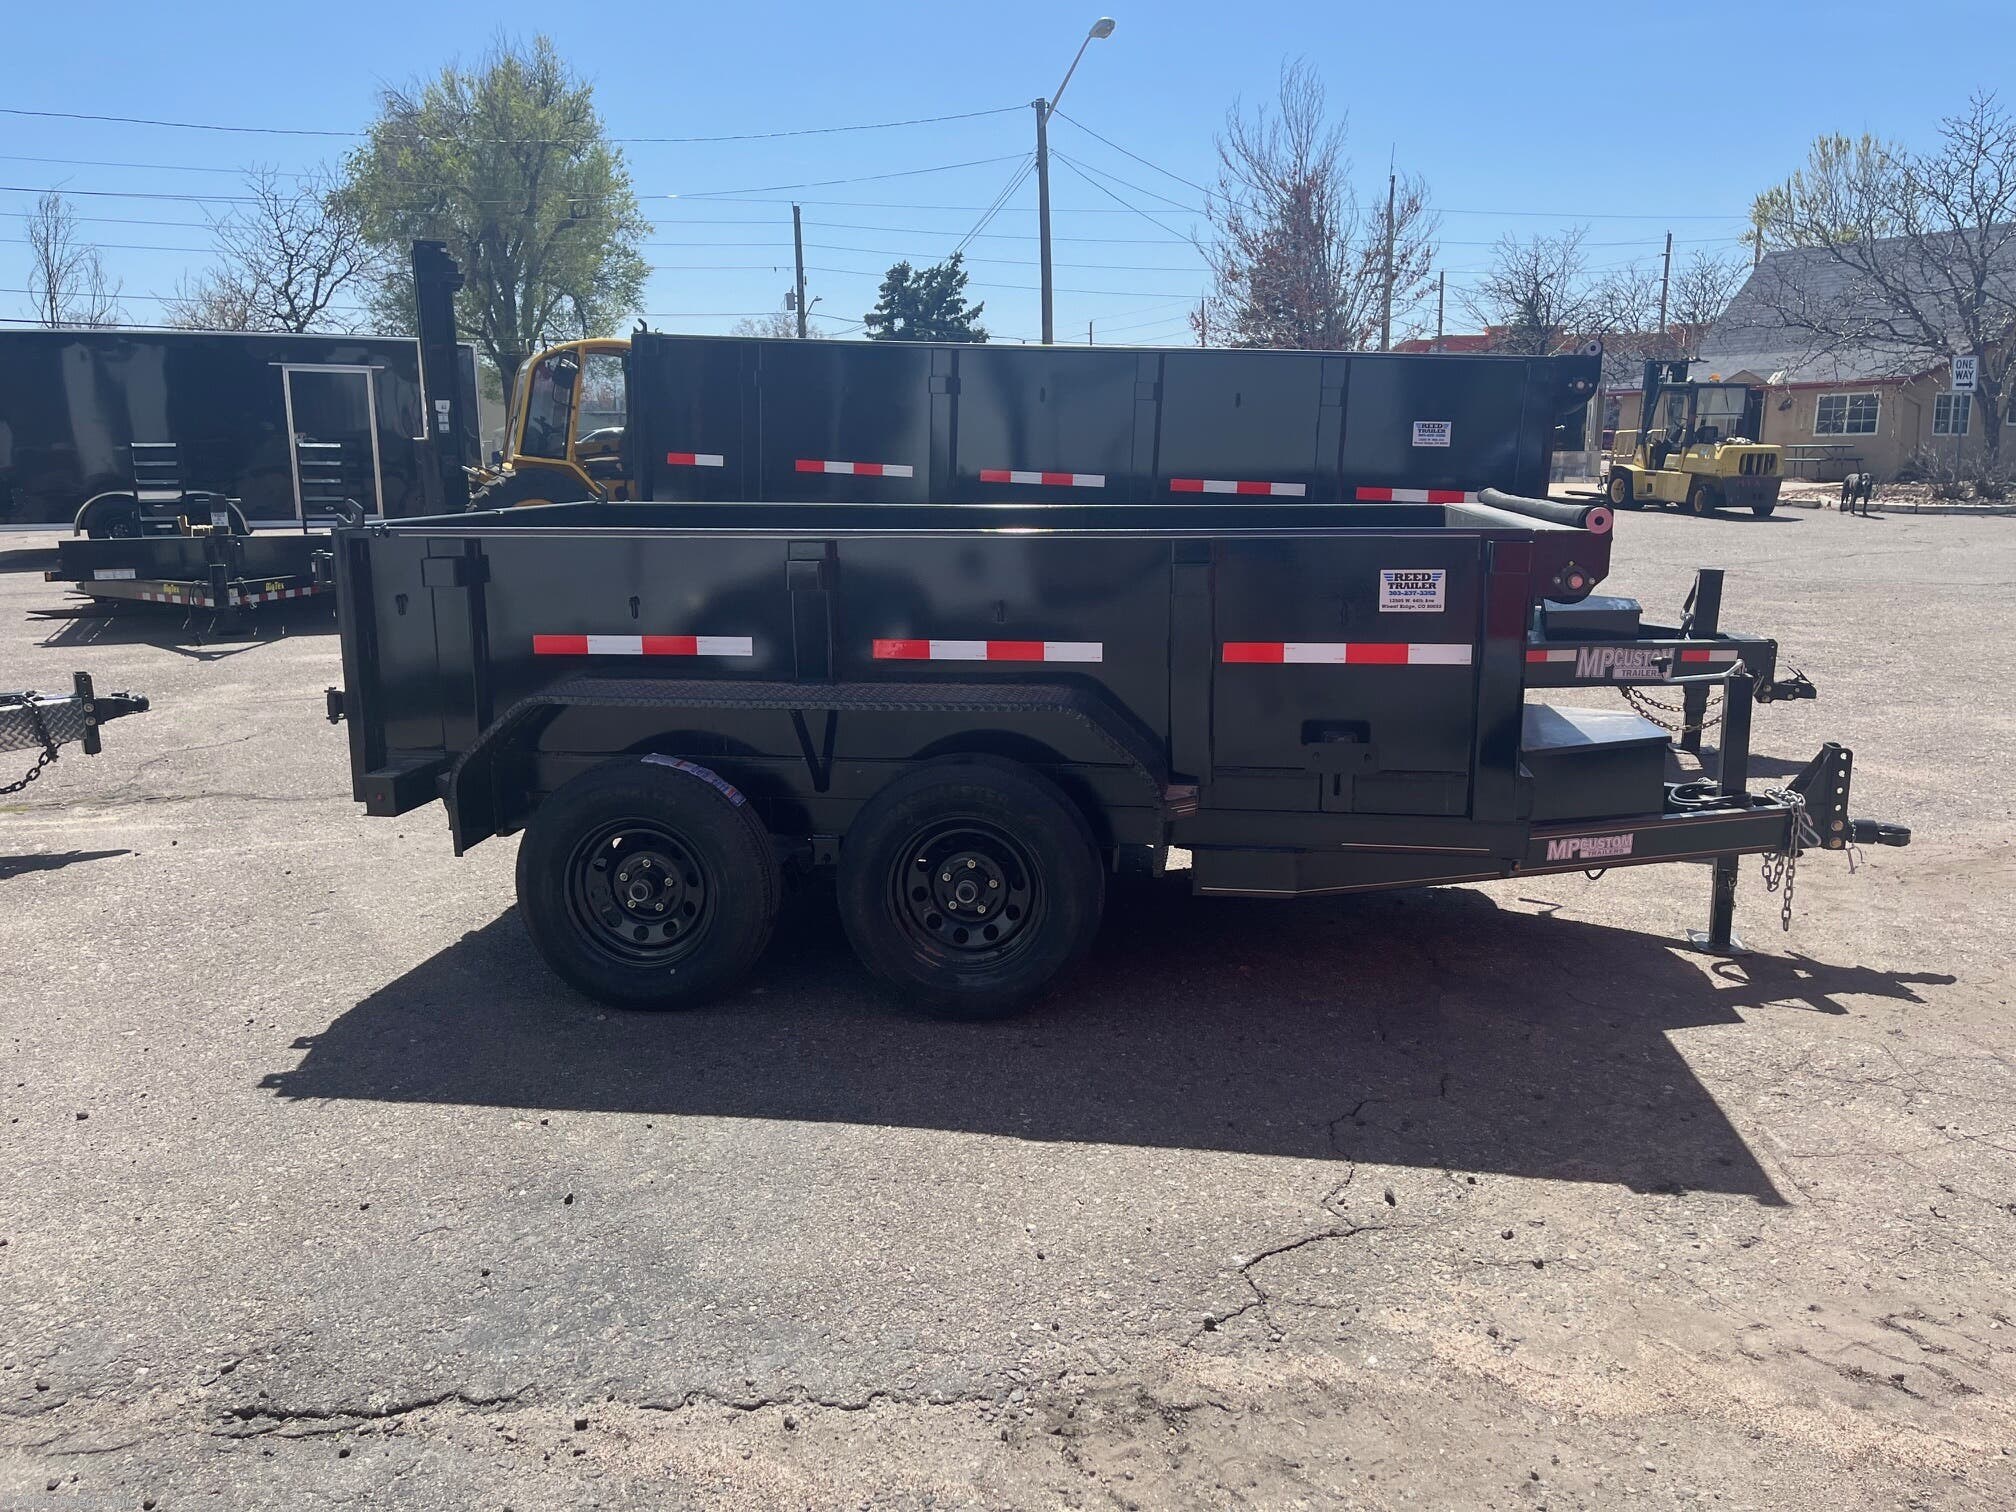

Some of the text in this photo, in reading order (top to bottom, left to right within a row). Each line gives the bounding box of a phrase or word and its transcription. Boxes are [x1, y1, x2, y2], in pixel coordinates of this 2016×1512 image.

[1956, 360, 1974, 369] ONE
[1955, 370, 1974, 380] WAY
[1394, 573, 1431, 581] REED
